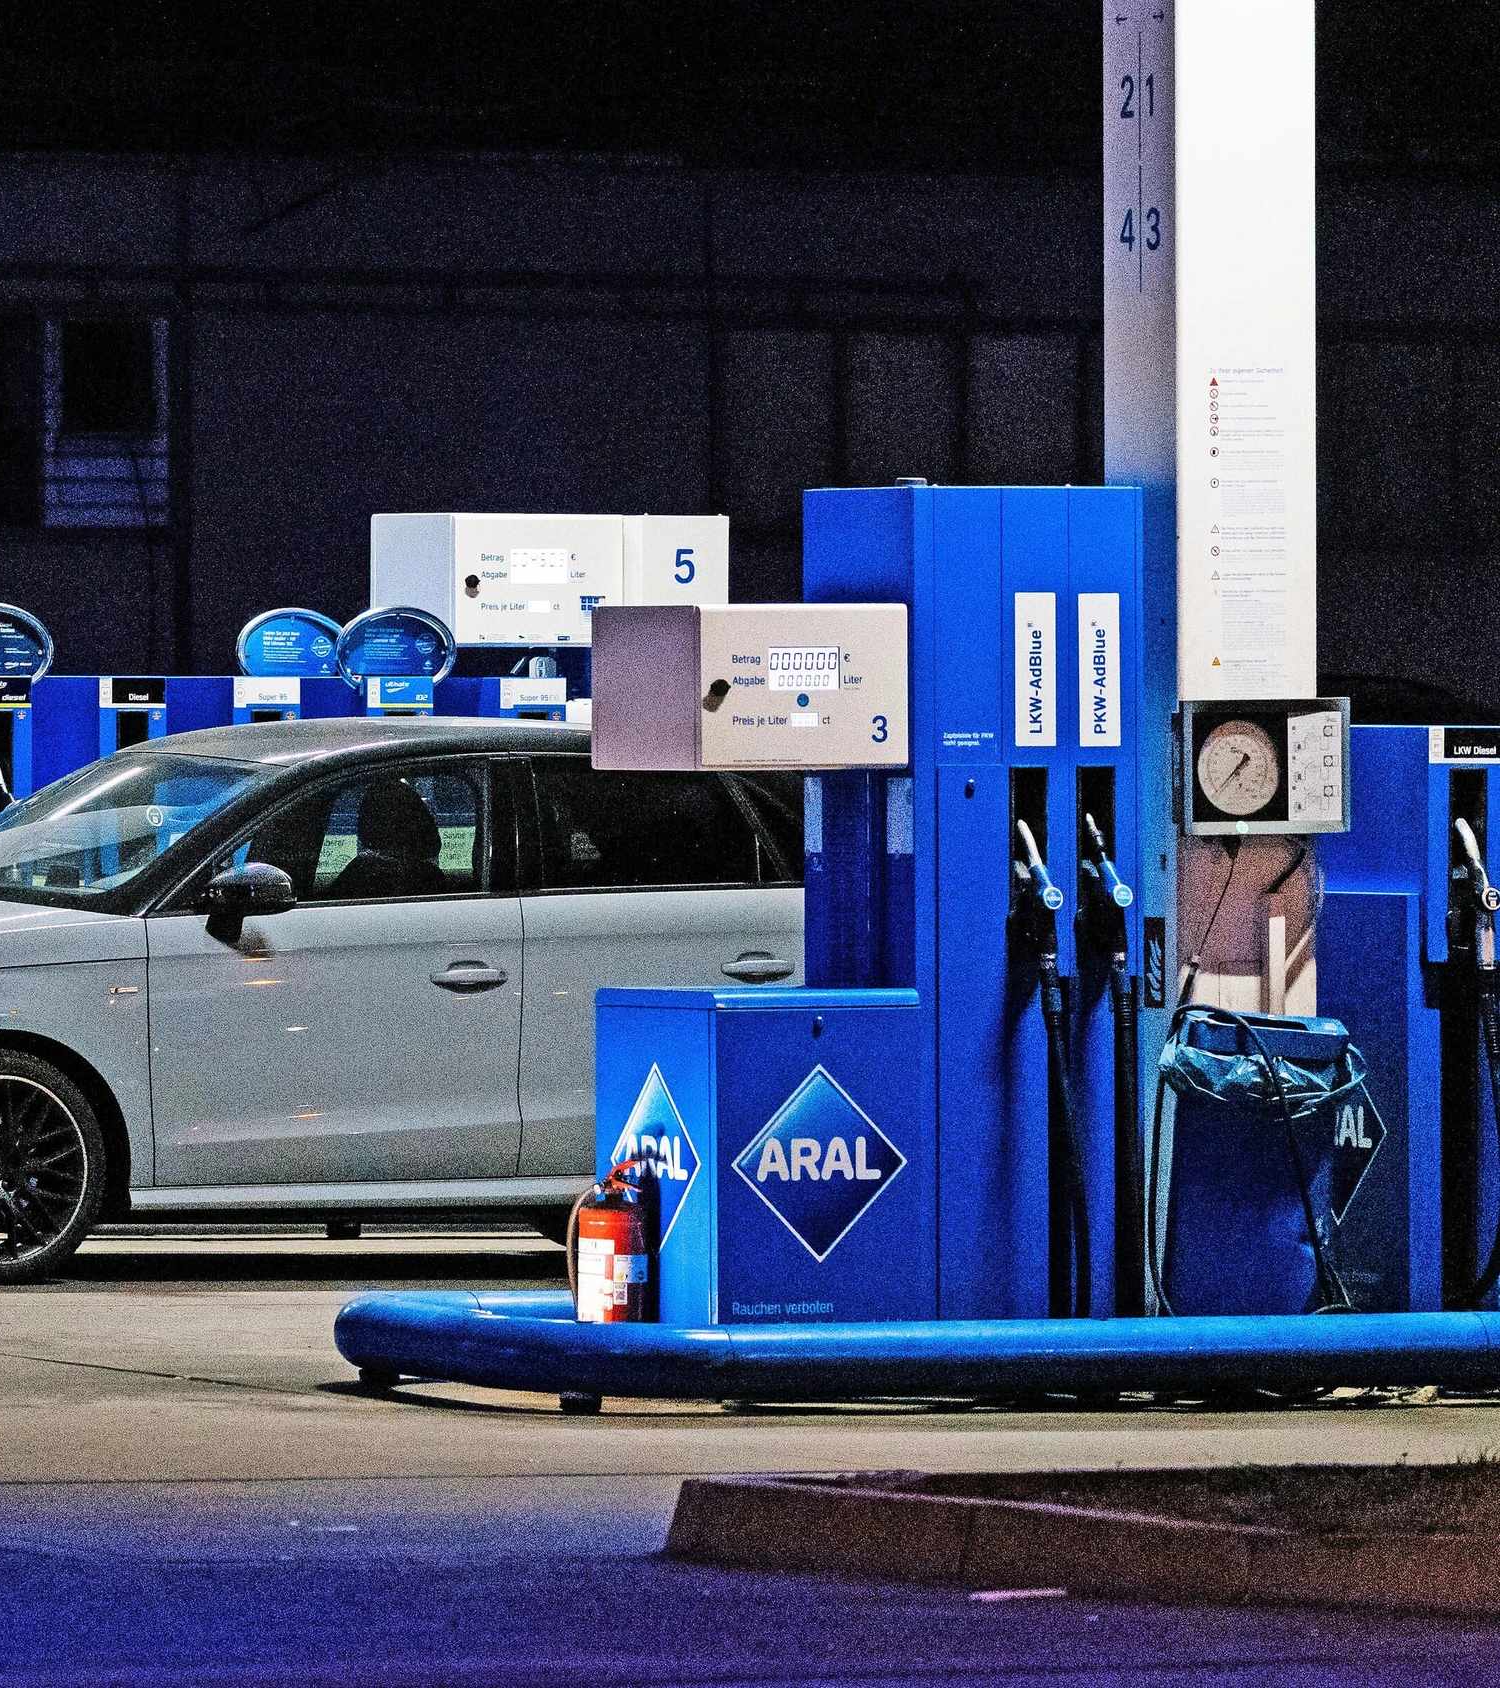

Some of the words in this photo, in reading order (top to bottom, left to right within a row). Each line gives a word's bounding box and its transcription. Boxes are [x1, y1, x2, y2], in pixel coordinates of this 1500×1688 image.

[1120, 75, 1134, 119] 2
[1146, 73, 1154, 117] 1
[1120, 208, 1135, 252] 4
[1146, 207, 1161, 251] 3
[480, 553, 505, 562] Betrag
[570, 553, 577, 561] €
[673, 547, 696, 584] 5
[480, 571, 508, 580] Abgabe
[570, 571, 587, 579] Liter
[480, 602, 500, 610] Preis
[500, 602, 508, 612] je
[509, 602, 526, 611] Liter
[553, 603, 561, 611] ct
[732, 654, 761, 665] Betrag
[843, 653, 851, 662] €
[732, 676, 766, 687] Abgabe
[843, 675, 863, 684] Liter
[1, 693, 27, 701] diesel
[128, 693, 150, 701] Diesel
[258, 693, 278, 702] Super
[279, 693, 288, 701] 95
[520, 694, 539, 702] Super
[540, 694, 549, 702] 95
[732, 715, 755, 726] Preis
[757, 715, 765, 727] je
[768, 715, 788, 725] Liter
[822, 715, 831, 725] ct
[871, 715, 888, 743] 3
[1453, 745, 1472, 755] LKW
[1473, 745, 1497, 755] Diesel
[623, 1133, 688, 1181] ARAL
[756, 1136, 881, 1183] ARAL
[731, 1301, 782, 1316] Rauchen
[784, 1299, 834, 1314] verboten
